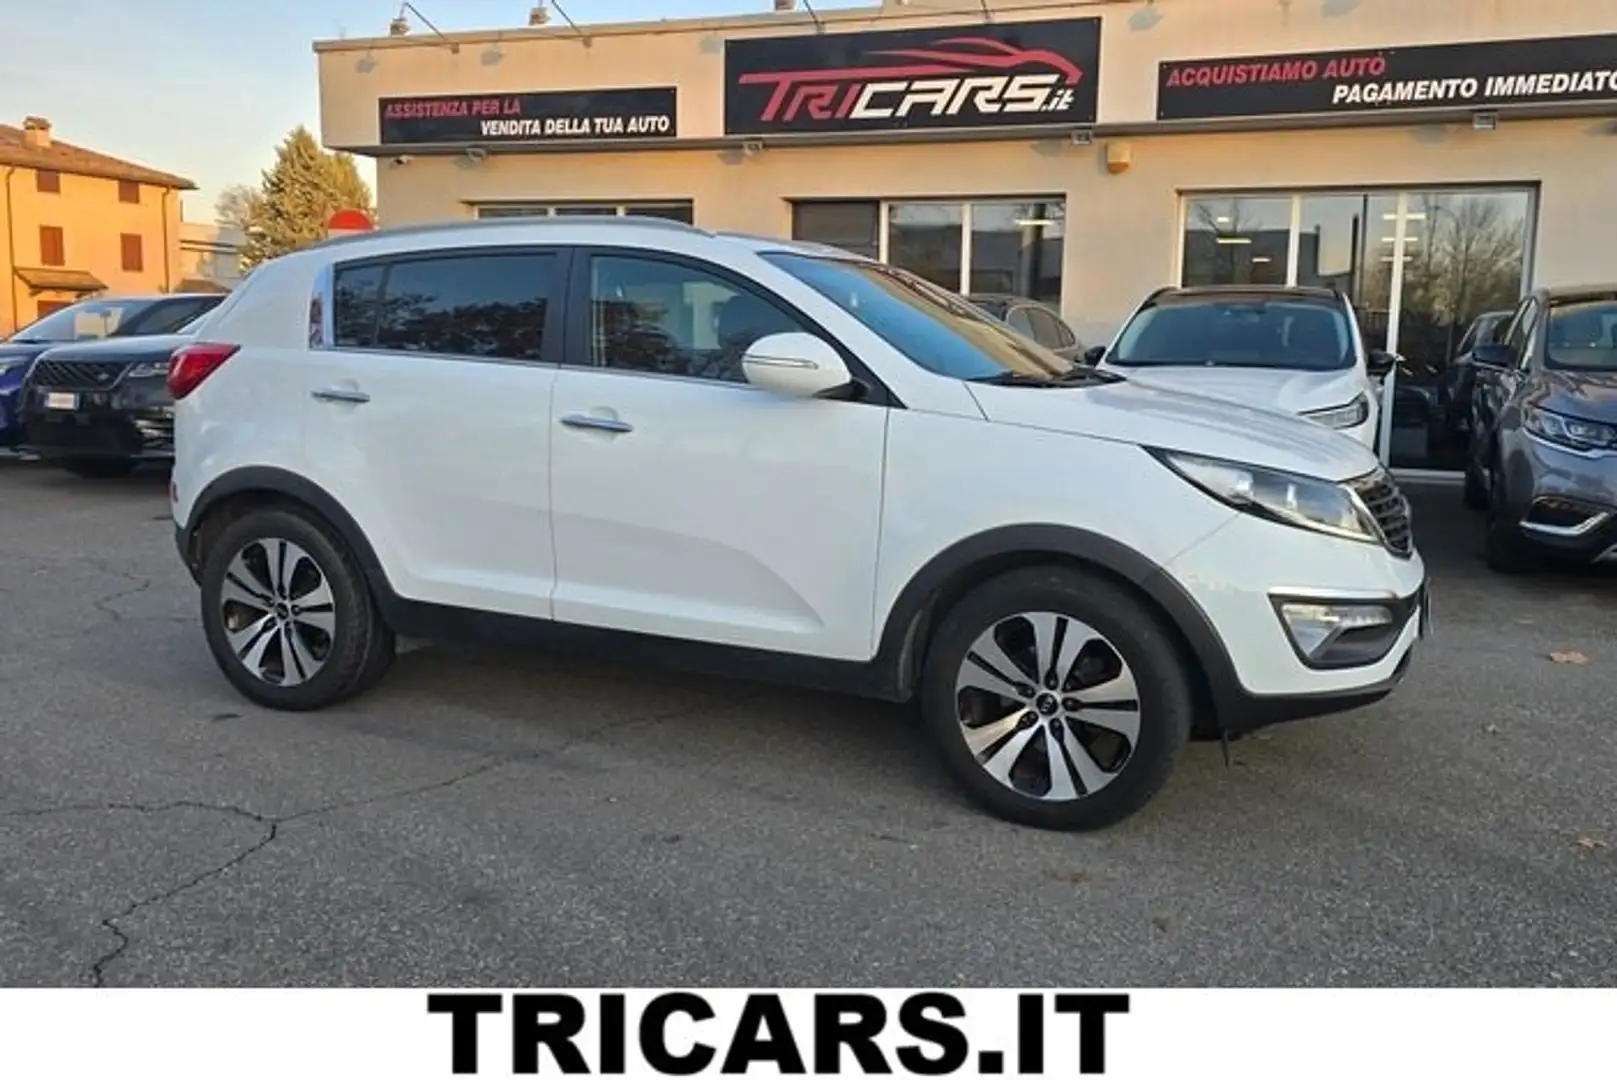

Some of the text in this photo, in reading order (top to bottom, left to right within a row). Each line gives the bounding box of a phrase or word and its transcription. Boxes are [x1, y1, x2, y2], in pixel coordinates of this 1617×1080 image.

[1166, 56, 1386, 88] ACQUISTIAMO AUTO
[1332, 77, 1478, 104] PAGAMENTO
[384, 97, 521, 118] ASSISTENZA PER LA
[480, 115, 670, 137] VENDITA DELLA TUA AUTO
